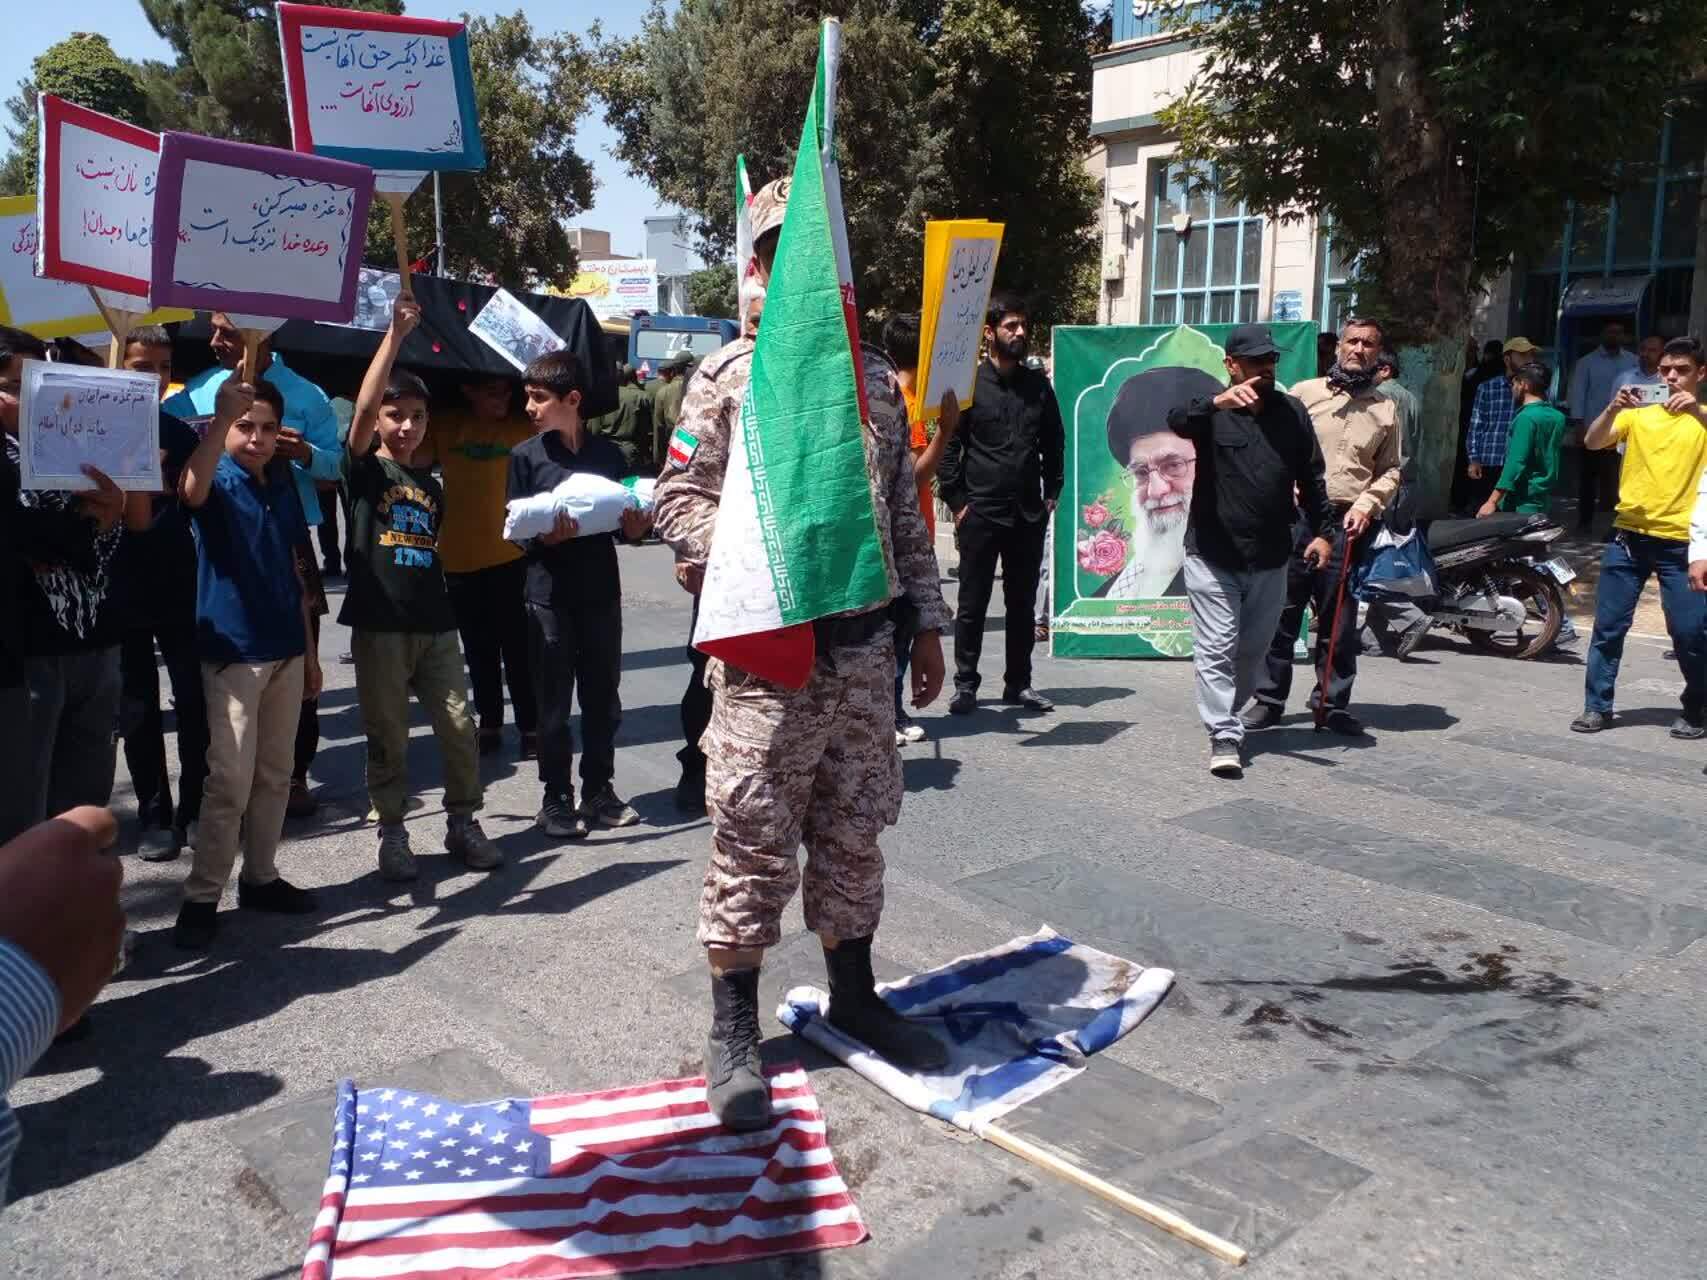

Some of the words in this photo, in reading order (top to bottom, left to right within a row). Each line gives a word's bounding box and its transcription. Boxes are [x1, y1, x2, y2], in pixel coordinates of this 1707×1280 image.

[301, 30, 339, 60] نیست
[336, 31, 365, 69] آنها
[358, 44, 391, 70] حق
[387, 36, 421, 75] دیگر
[421, 40, 447, 69] غذا
[379, 80, 421, 117] آرزوی
[114, 163, 139, 192] نان
[279, 201, 307, 218] صبر
[232, 218, 276, 252] نزدیک
[282, 231, 301, 251] خدا
[303, 237, 329, 256] وعده
[391, 533, 412, 544] NEW
